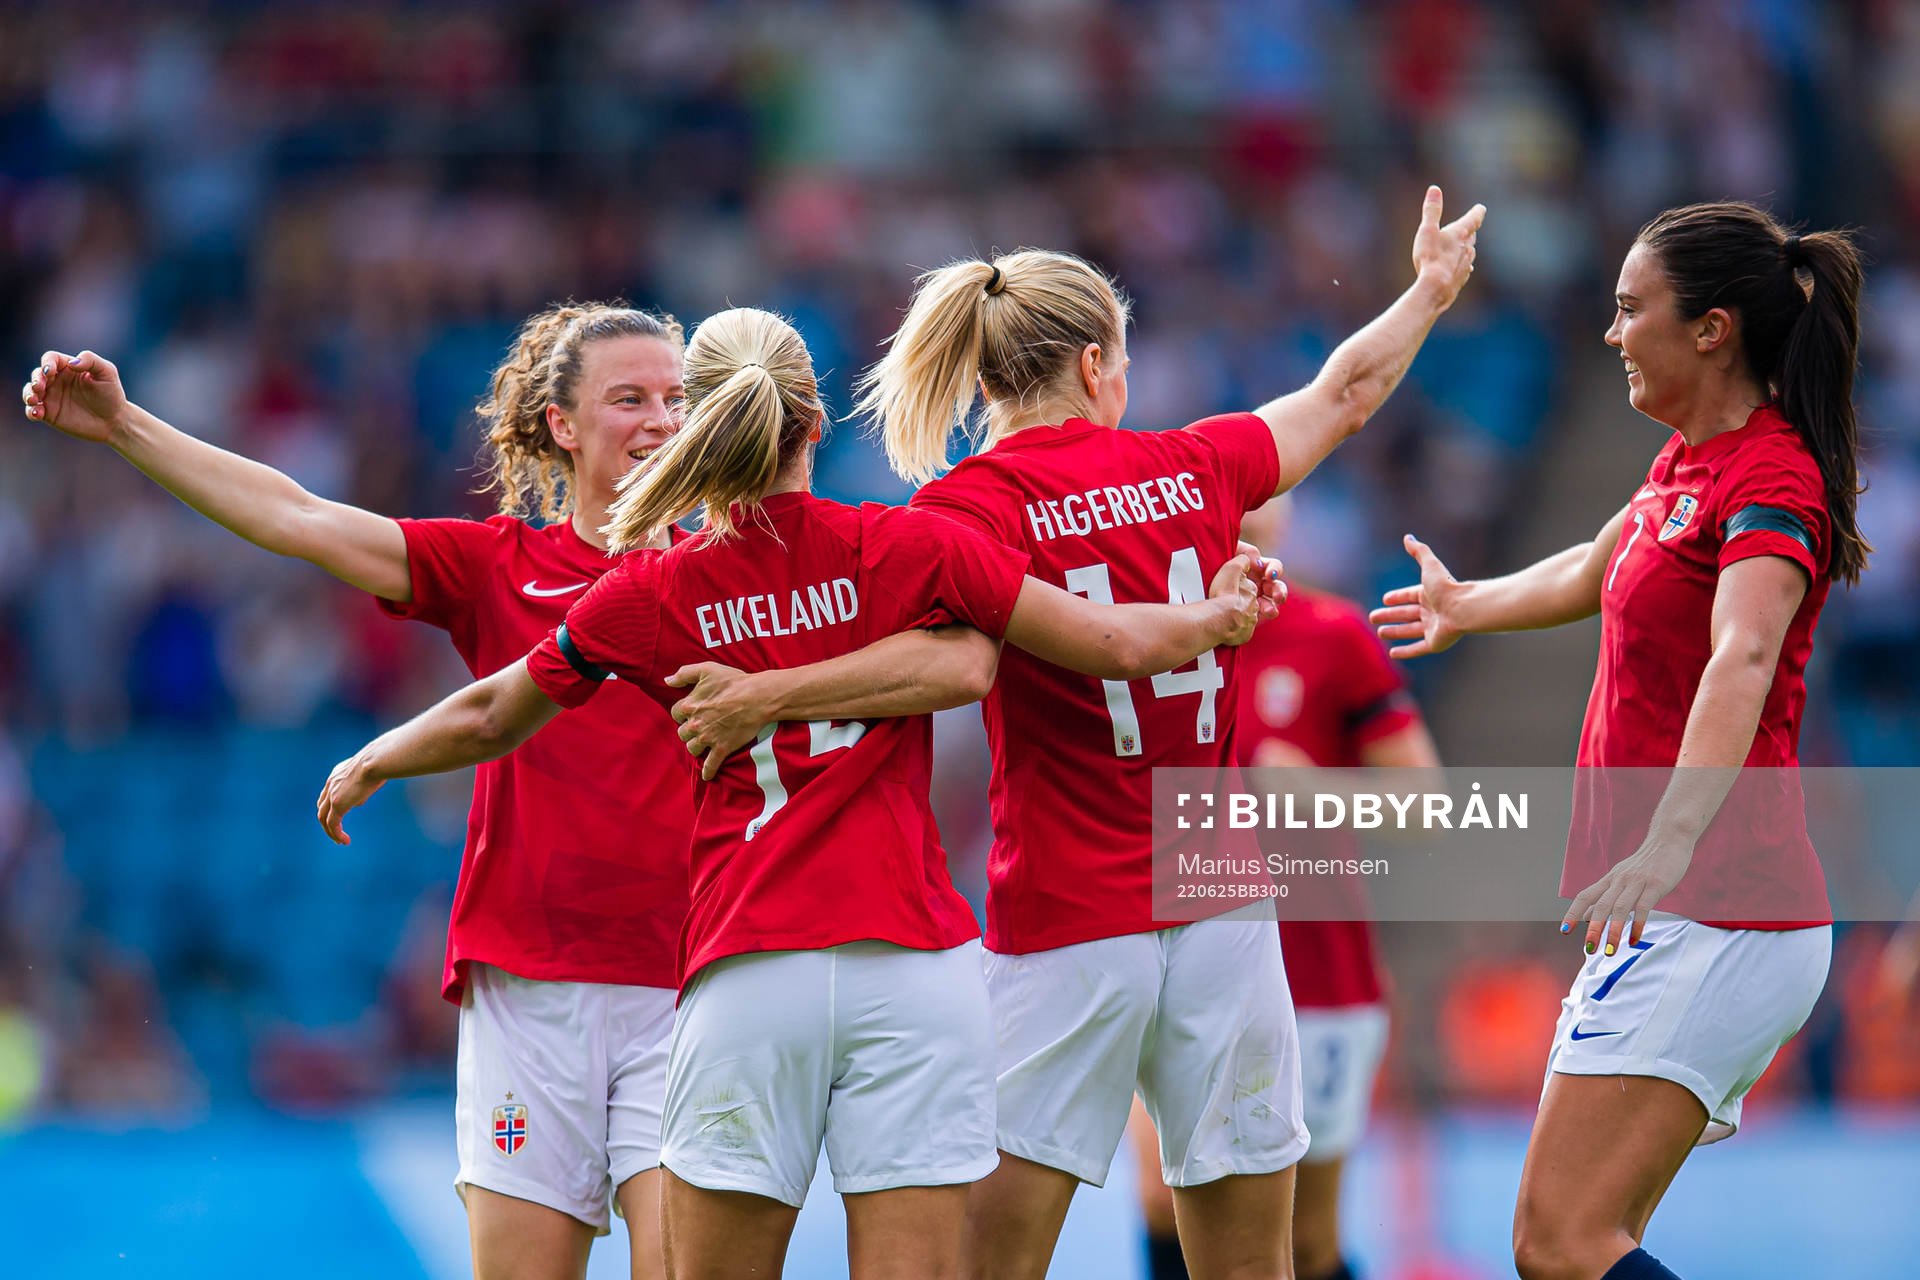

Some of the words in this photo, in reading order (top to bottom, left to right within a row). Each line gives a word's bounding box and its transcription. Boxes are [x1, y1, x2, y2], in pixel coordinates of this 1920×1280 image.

[1026, 472, 1204, 541] HEGERBERG
[695, 577, 859, 649] EIKELAND
[1589, 940, 1656, 1001] 7
